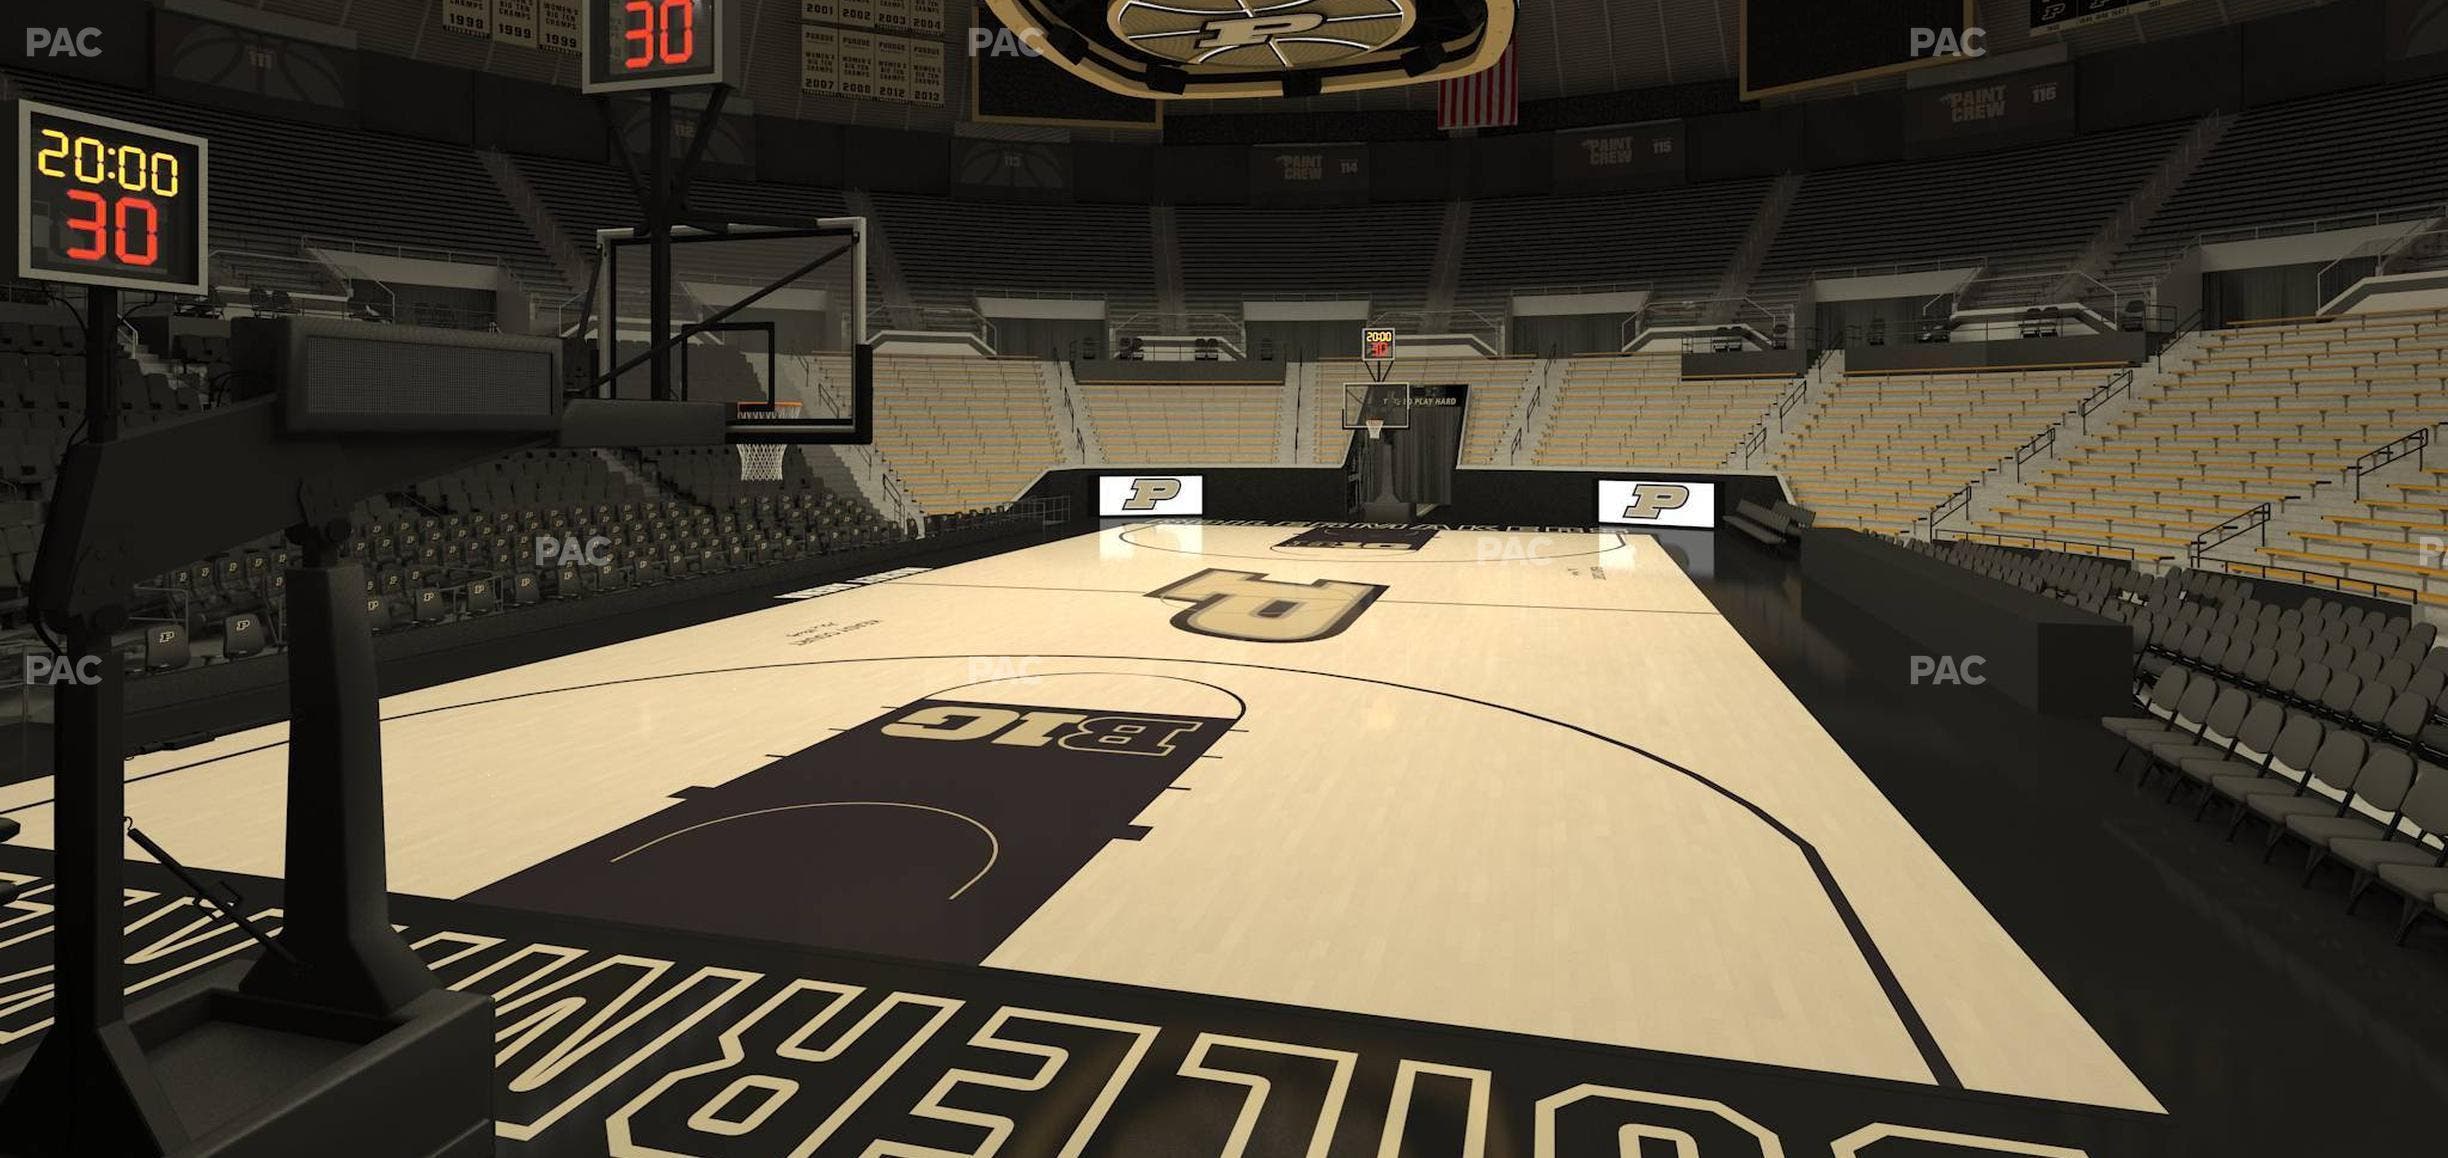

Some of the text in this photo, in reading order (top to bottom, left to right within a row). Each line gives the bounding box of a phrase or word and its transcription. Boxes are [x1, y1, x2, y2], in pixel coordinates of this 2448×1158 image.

[806, 4, 834, 15] 2001
[843, 8, 871, 20] 2002
[498, 23, 532, 39] 1999
[913, 18, 941, 30] 2004
[1194, 13, 1328, 49] P
[545, 33, 577, 48] 1999
[625, 0, 693, 69] 30
[805, 78, 835, 90] 2007
[842, 82, 871, 94] 2008
[879, 86, 906, 98] 2012
[914, 90, 940, 102] 2013
[1951, 84, 2008, 107] PAINT
[2031, 86, 2057, 104] 116
[1951, 100, 2007, 122] CREW
[1588, 137, 1633, 151] PAINT
[1652, 140, 1672, 154] 115
[38, 128, 178, 197] 20:00
[1590, 150, 1633, 165] CREW
[1341, 162, 1358, 174] 114
[66, 188, 158, 266] 30
[1366, 331, 1392, 342] 20:00
[1414, 398, 1433, 406] PLAY
[1434, 398, 1457, 406] HARD
[1122, 478, 1181, 511] P
[1623, 483, 1690, 520] P
